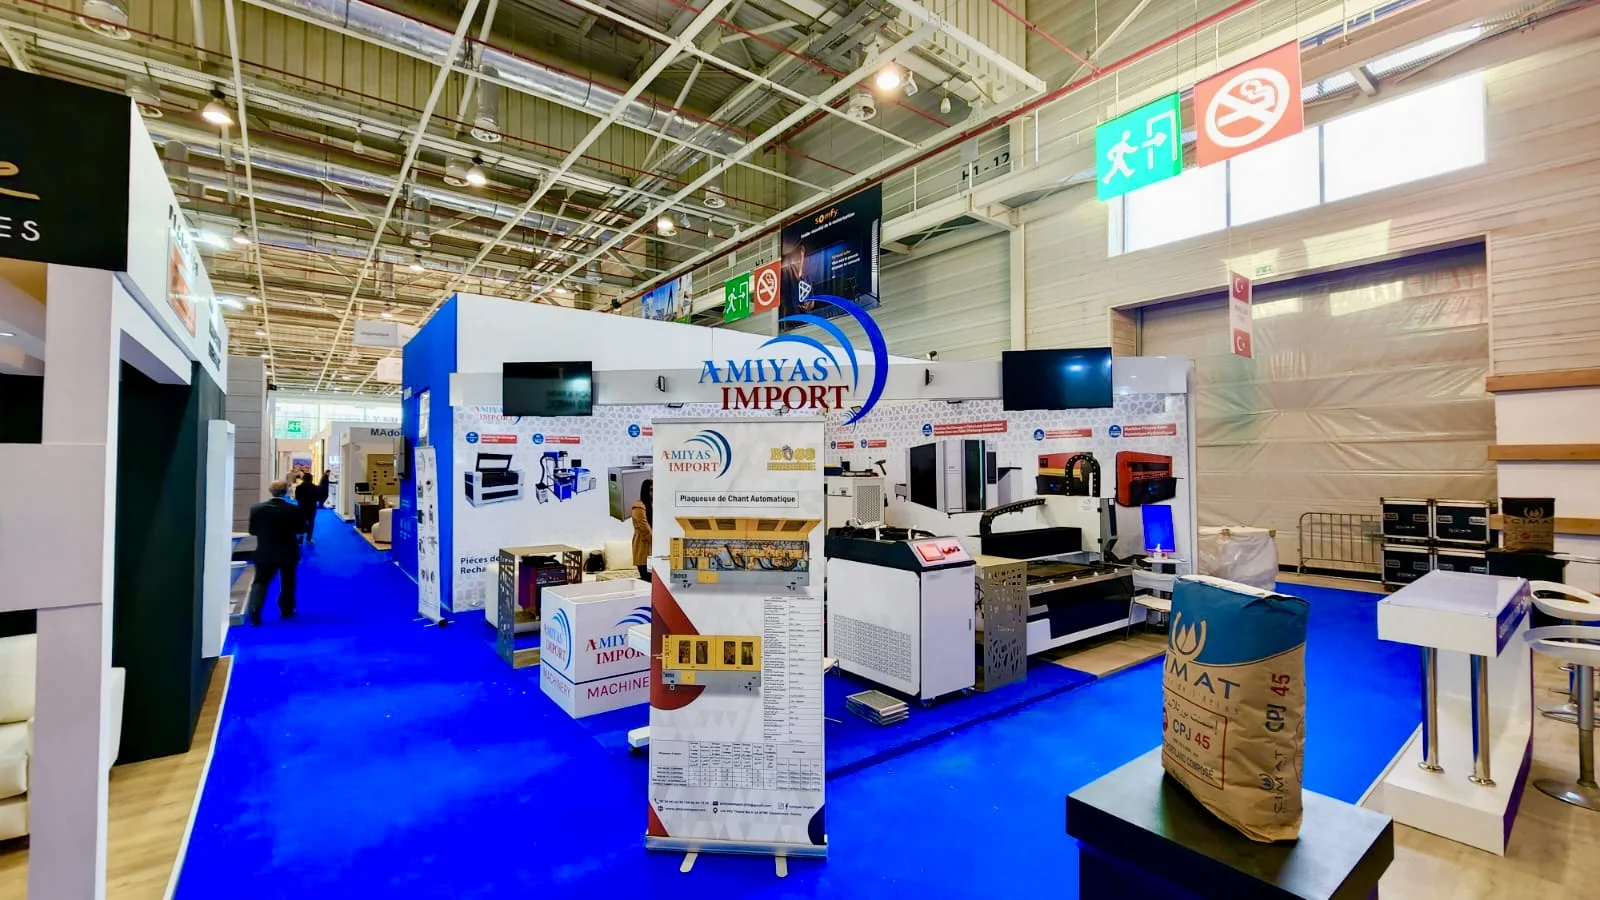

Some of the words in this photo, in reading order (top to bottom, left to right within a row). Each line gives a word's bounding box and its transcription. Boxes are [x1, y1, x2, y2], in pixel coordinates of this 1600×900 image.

[814, 208, 838, 225] somfy
[698, 357, 829, 384] AMIYAS
[721, 385, 849, 410] IMPORT
[661, 449, 711, 460] AMIYAS
[669, 462, 719, 472] IMPORT
[680, 495, 716, 503] Plaqueuse
[750, 495, 796, 504] Automatique
[1270, 673, 1291, 697] 45
[1265, 704, 1287, 733] CPJ
[1172, 718, 1192, 741] CPJ
[1194, 732, 1211, 750] 45
